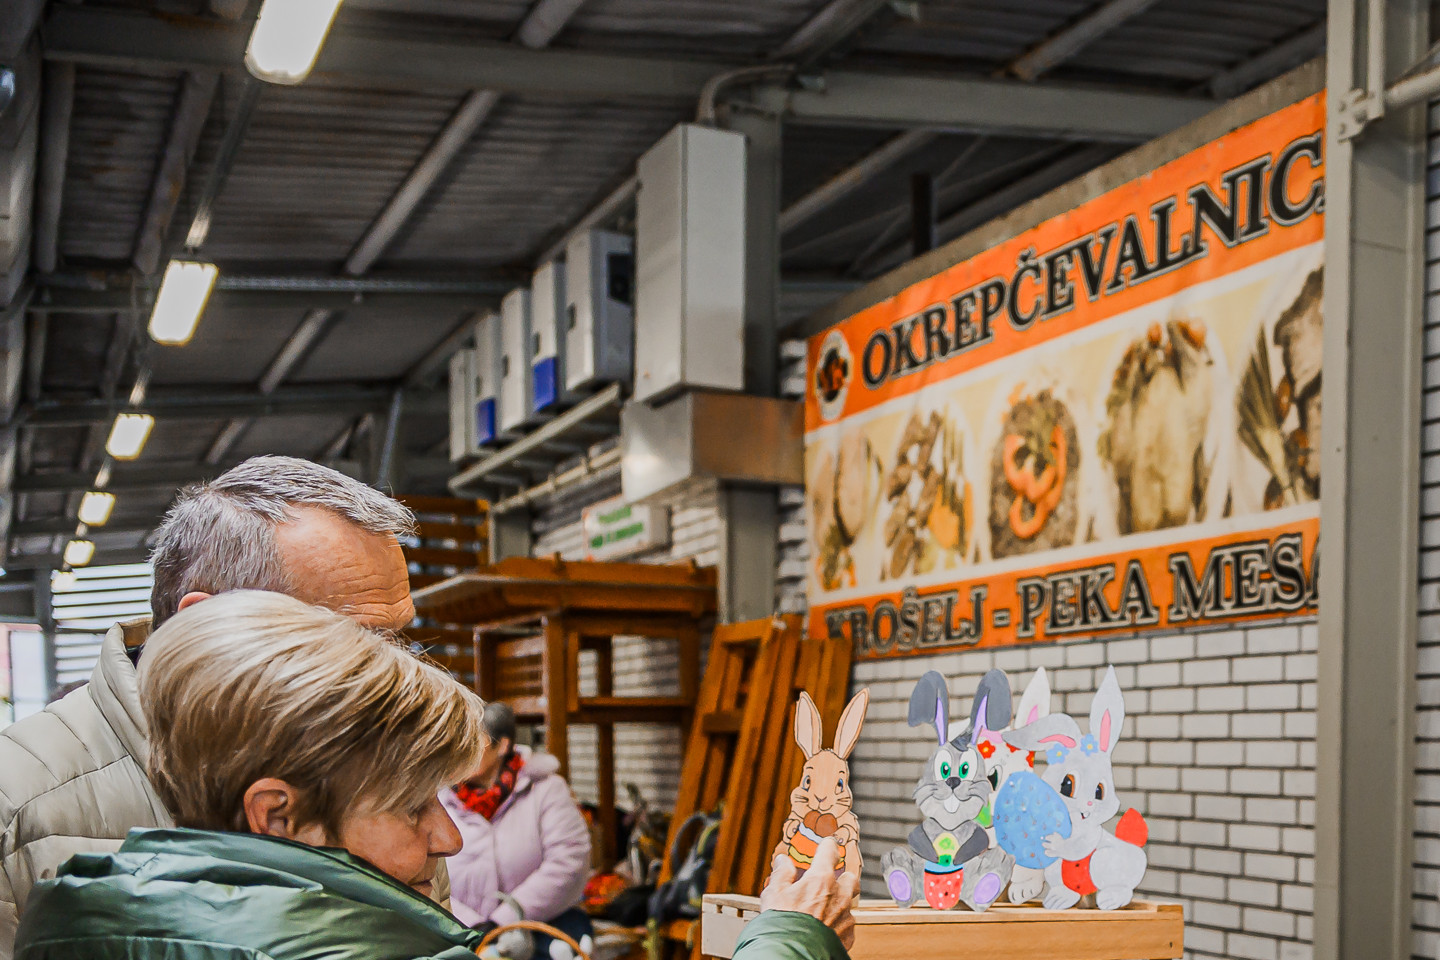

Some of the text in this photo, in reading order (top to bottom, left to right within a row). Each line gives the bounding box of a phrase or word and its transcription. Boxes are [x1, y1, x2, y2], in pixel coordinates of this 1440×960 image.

[861, 129, 1326, 390] OKREPČEVALNIC
[1016, 558, 1160, 638] PEKA
[1168, 532, 1319, 623] MES
